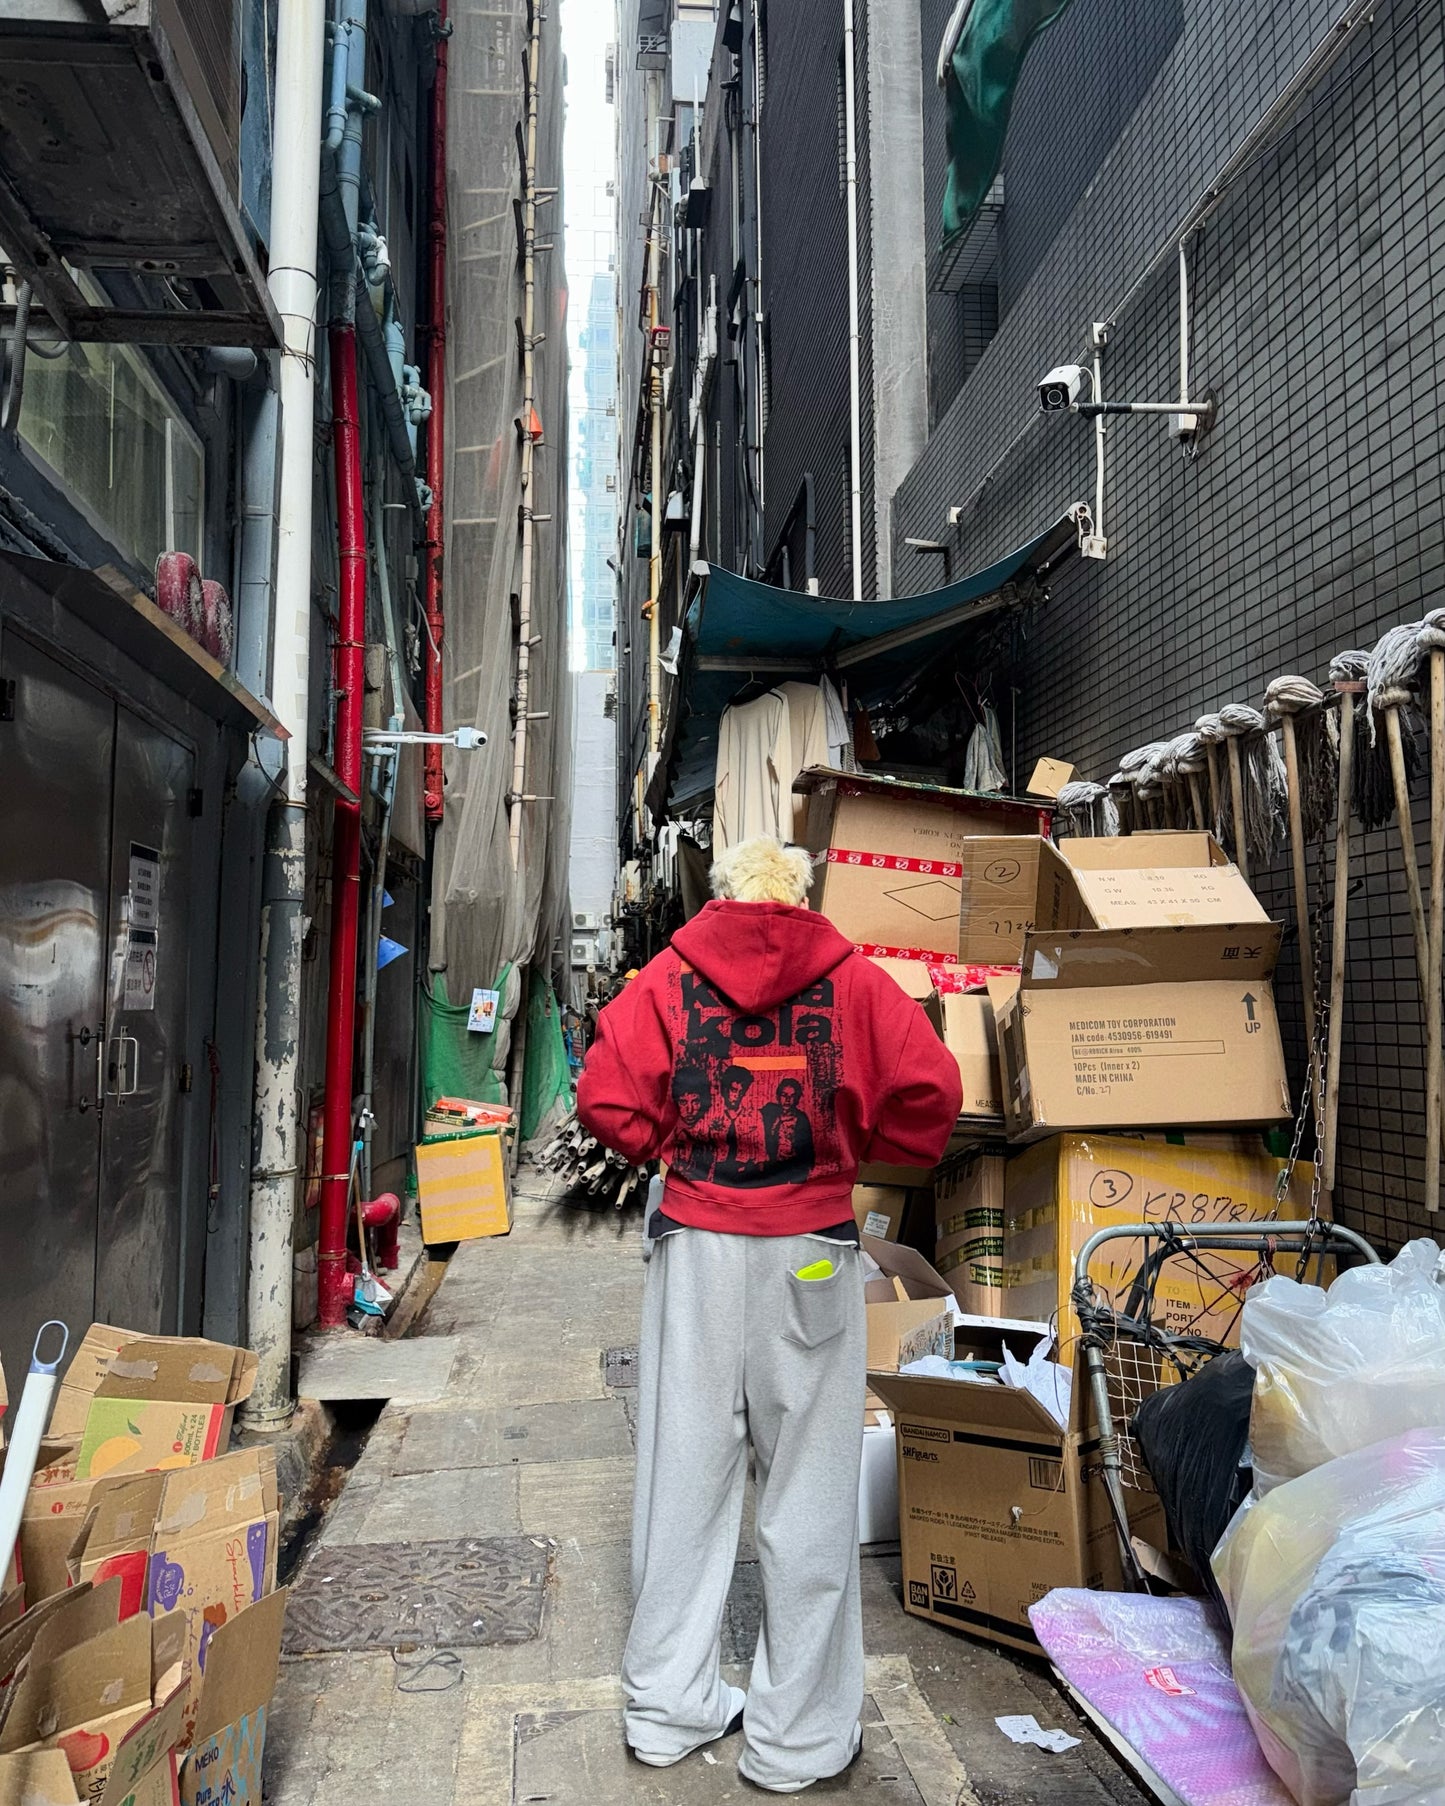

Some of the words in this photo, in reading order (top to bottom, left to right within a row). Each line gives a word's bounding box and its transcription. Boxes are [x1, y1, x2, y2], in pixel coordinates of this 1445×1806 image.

[913, 828, 940, 838] KOREA
[1069, 1020, 1105, 1031] MEDICOM
[1107, 1019, 1121, 1030] TOY
[1122, 1017, 1176, 1029] CORPORATION
[1245, 1022, 1261, 1033] UP
[1073, 1062, 1096, 1072] 10Pcs
[1100, 1061, 1124, 1072] (Inner
[1132, 1060, 1140, 1072] 2)
[1075, 1074, 1097, 1084] MADE
[1099, 1073, 1107, 1083] IN
[1109, 1073, 1134, 1083] CHINA
[1076, 1086, 1098, 1096] C/No.
[1166, 1299, 1190, 1309] ITEM
[1166, 1312, 1194, 1323] PORT
[1187, 1327, 1202, 1336] NO
[193, 1414, 206, 1451] BOTTLES
[903, 1426, 925, 1436] BANDAI
[925, 1430, 948, 1440] NAMCO
[1043, 1536, 1064, 1546] EDITION
[911, 1583, 928, 1597] BAN
[1031, 1582, 1048, 1592] MADE
[911, 1593, 925, 1605] DAI
[196, 1787, 212, 1806] Pure
